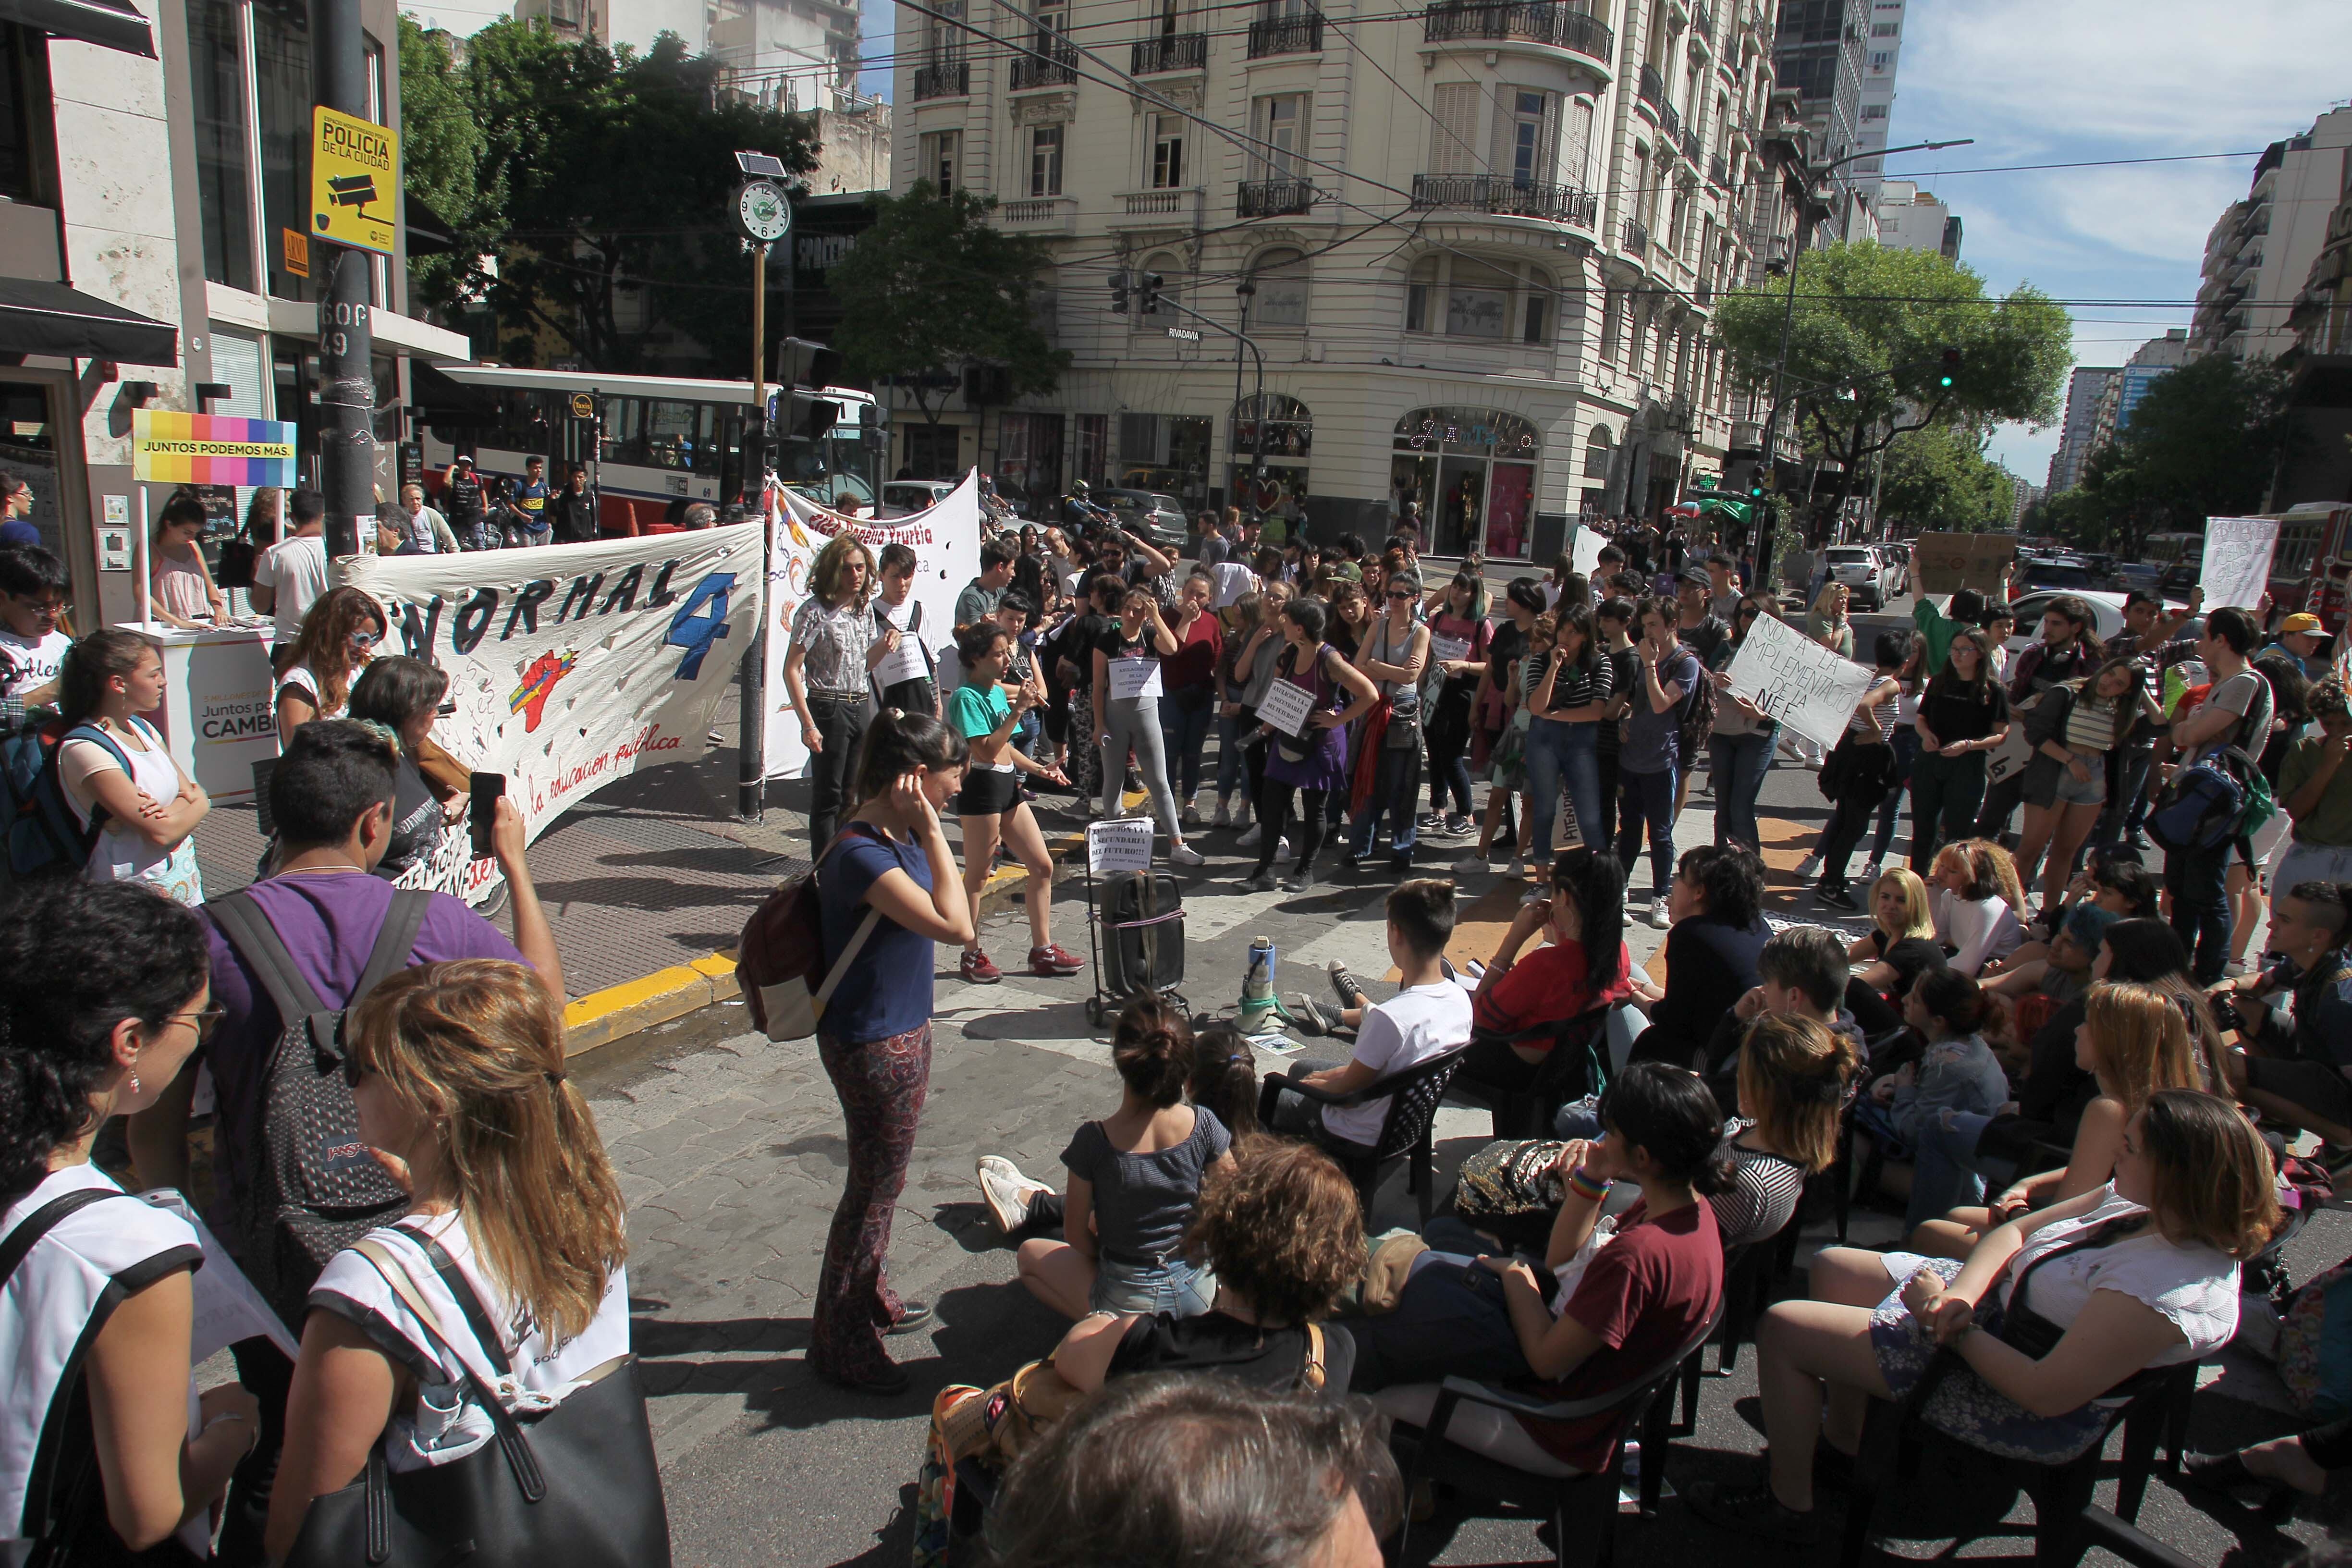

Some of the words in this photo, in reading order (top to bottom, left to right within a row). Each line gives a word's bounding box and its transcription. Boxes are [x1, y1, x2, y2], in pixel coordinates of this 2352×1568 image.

[324, 116, 343, 126] ESPACIO
[343, 123, 374, 136] MONITOREADO
[323, 122, 390, 159] POLICIA
[323, 141, 336, 154] DE
[339, 146, 352, 159] LA
[355, 151, 390, 171] CIUDAD
[761, 186, 770, 195] 12
[742, 201, 747, 212] 9
[782, 208, 787, 219] 3
[761, 227, 768, 237] 6
[1169, 328, 1199, 341] RIVADAVIA
[144, 441, 196, 453] JUNTOS
[200, 444, 261, 455] PODEMOS
[264, 444, 290, 456] MÁS.
[703, 487, 711, 498] 69
[886, 523, 933, 545] Yrurtia
[401, 559, 681, 665] NORMAL
[663, 572, 738, 680] 4
[1761, 617, 1785, 641] NO
[1795, 637, 1806, 656] A
[1817, 649, 1840, 675] LA
[1769, 677, 1792, 698] DE
[1791, 690, 1807, 709] LA
[202, 704, 252, 717] Juntos
[1753, 688, 1798, 721] NEF
[1097, 836, 1145, 845] SECUNDARIA
[1091, 848, 1102, 857] DEL
[1104, 847, 1144, 856] FUTURO!!!
